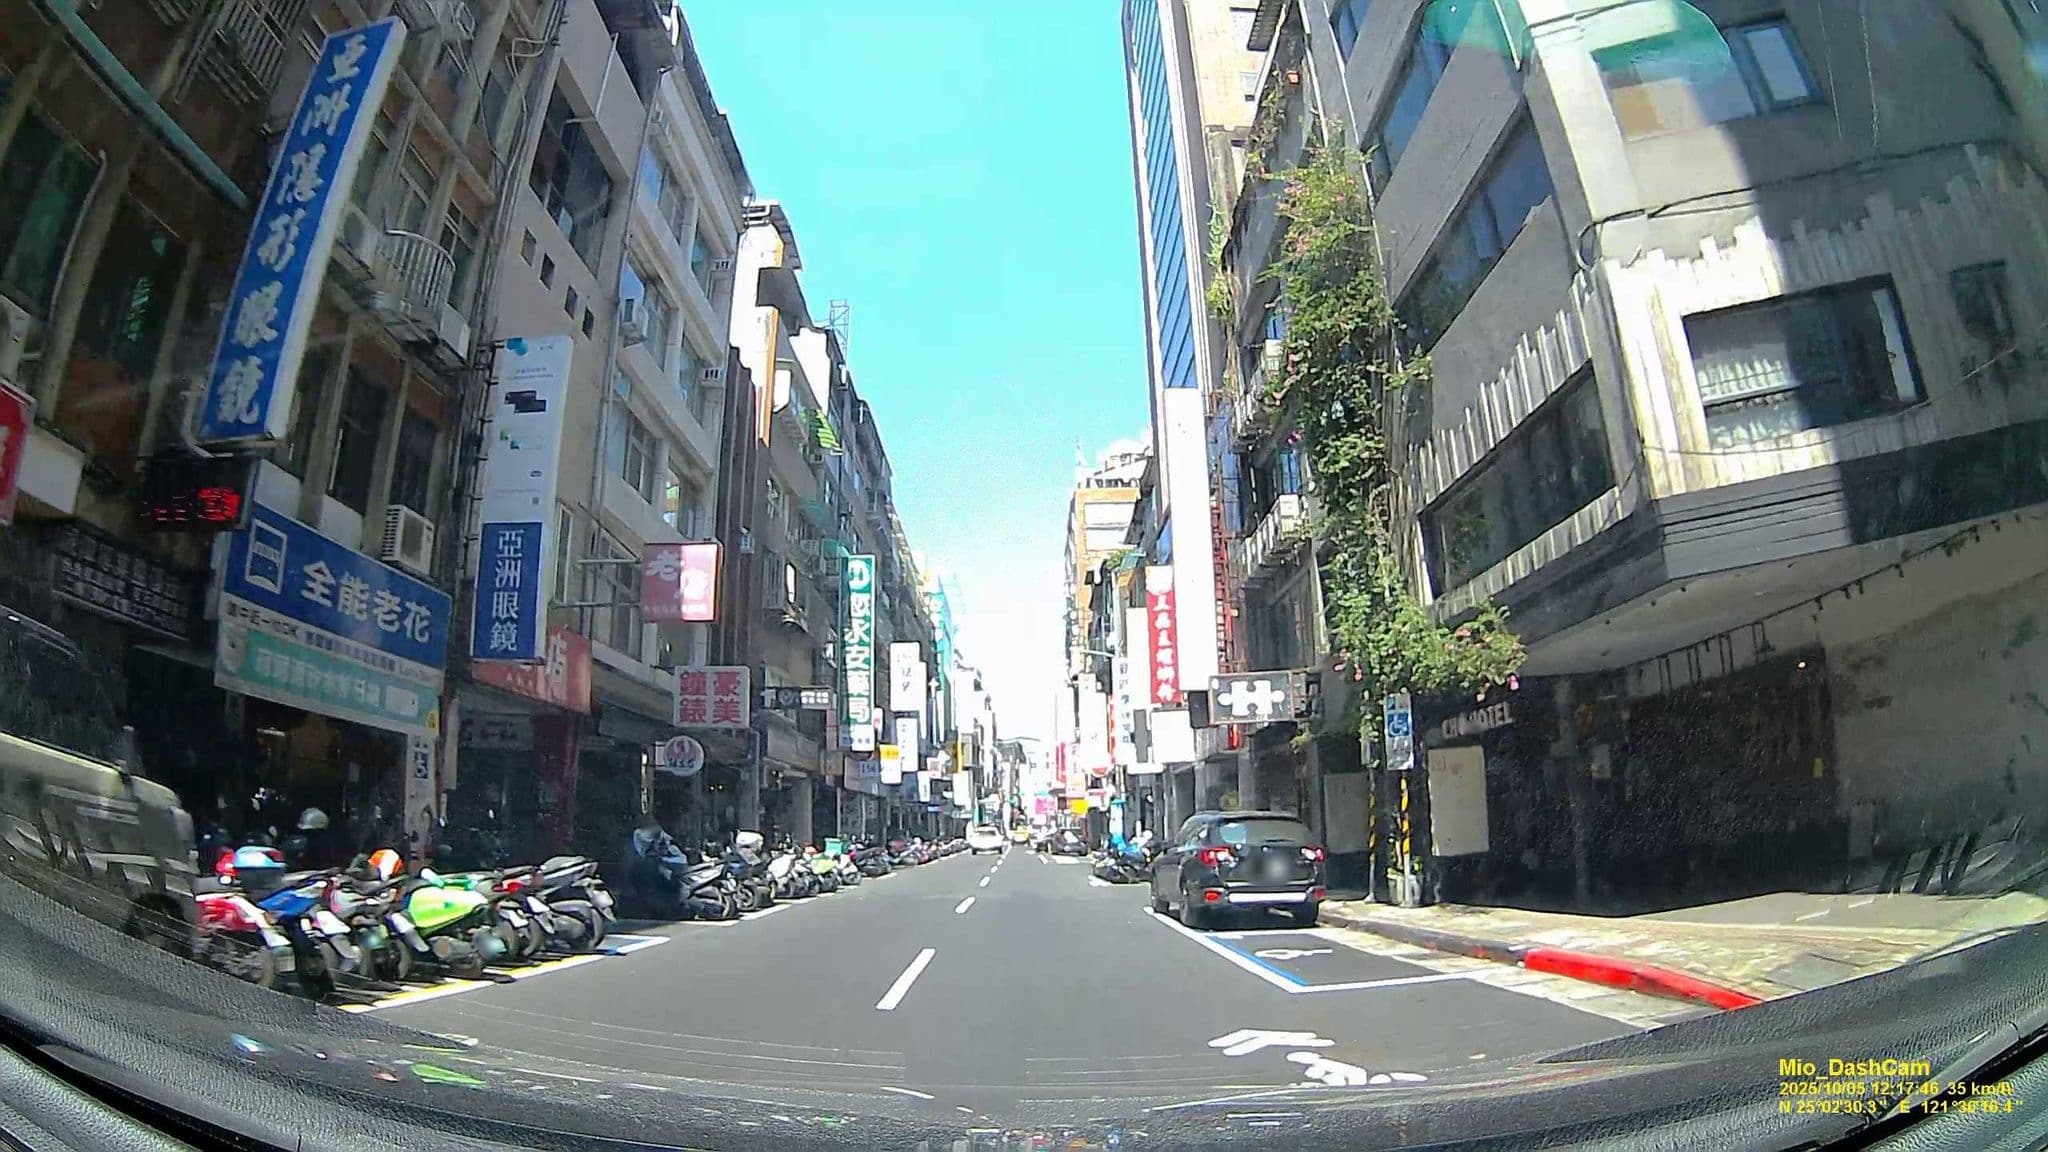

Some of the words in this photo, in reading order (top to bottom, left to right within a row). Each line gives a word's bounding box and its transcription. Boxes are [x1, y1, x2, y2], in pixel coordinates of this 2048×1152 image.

[301, 561, 432, 643] 全能老花
[489, 529, 525, 652] 亞洲眼鏡
